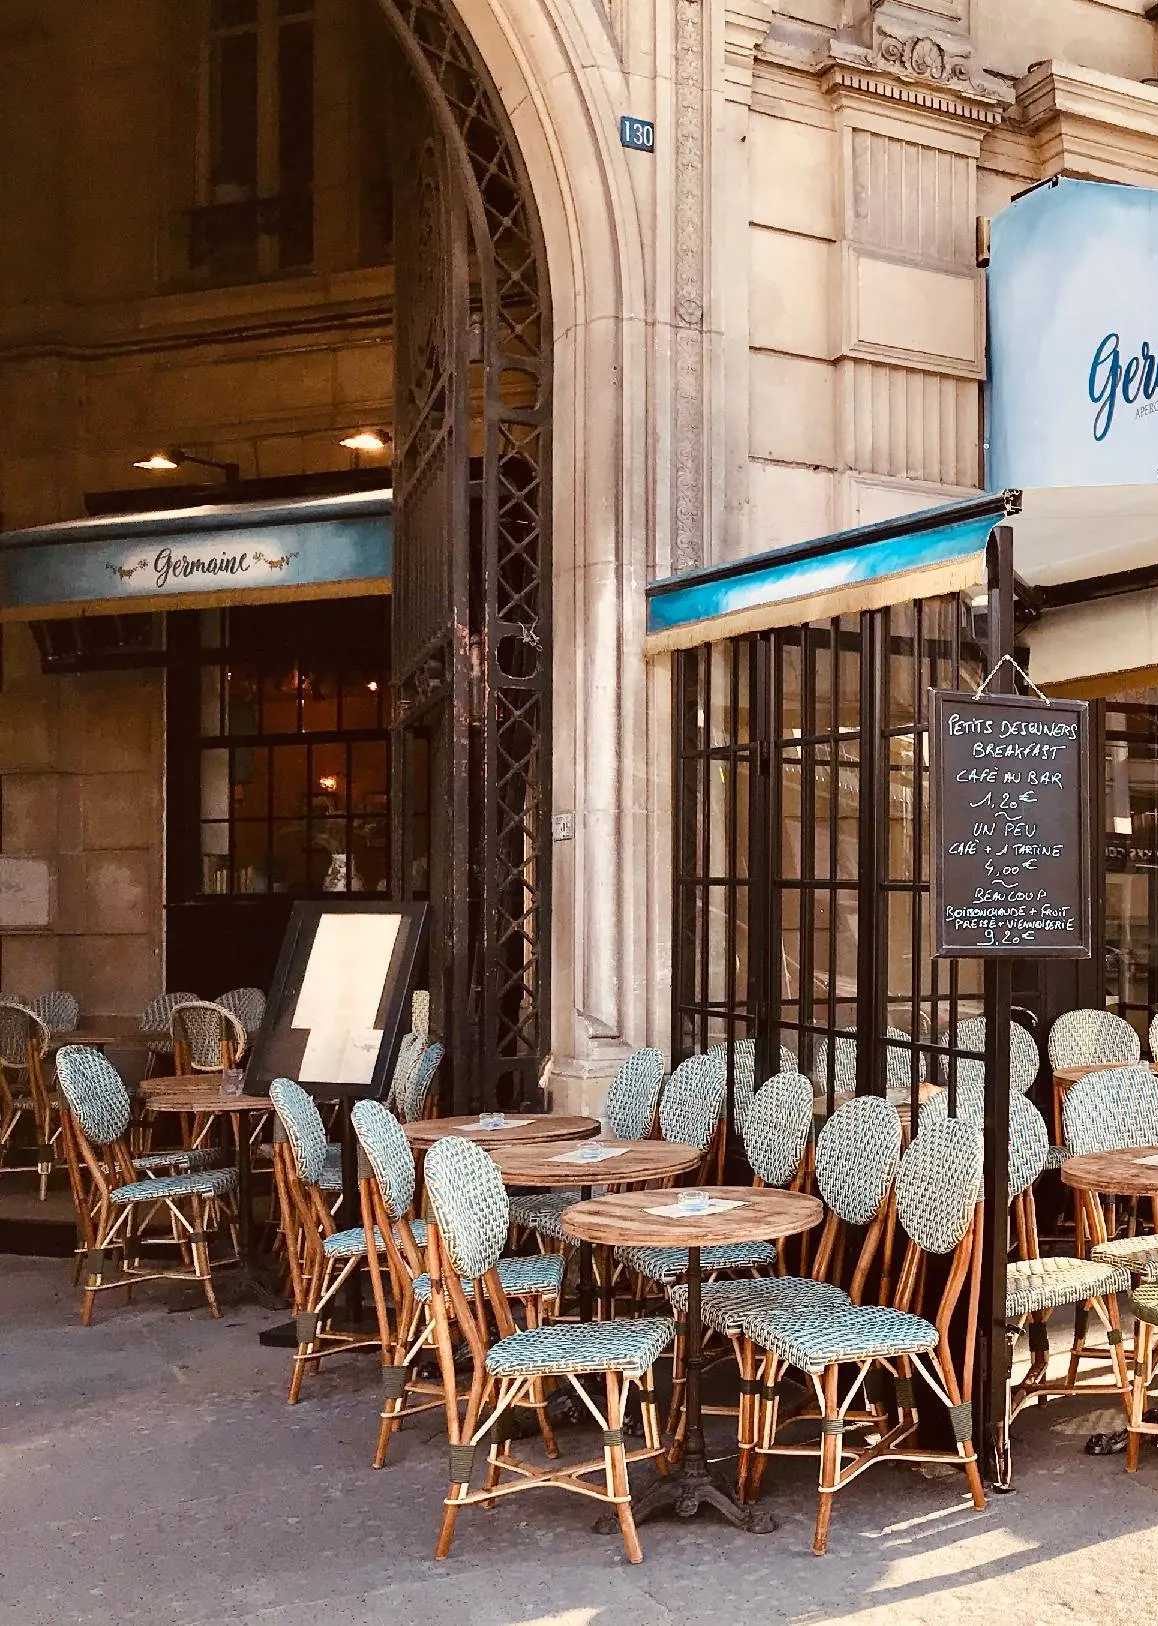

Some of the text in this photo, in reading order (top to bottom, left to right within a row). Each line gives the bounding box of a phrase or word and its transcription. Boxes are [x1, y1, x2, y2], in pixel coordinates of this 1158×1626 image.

[624, 120, 653, 147] 130
[153, 547, 251, 589] Germaine
[973, 742, 1066, 760] BREAKFAST
[1003, 771, 1021, 784] AU
[1028, 770, 1063, 790] BAR
[973, 822, 1036, 837] UN PEU
[972, 887, 1047, 904] BEAUCOUP
